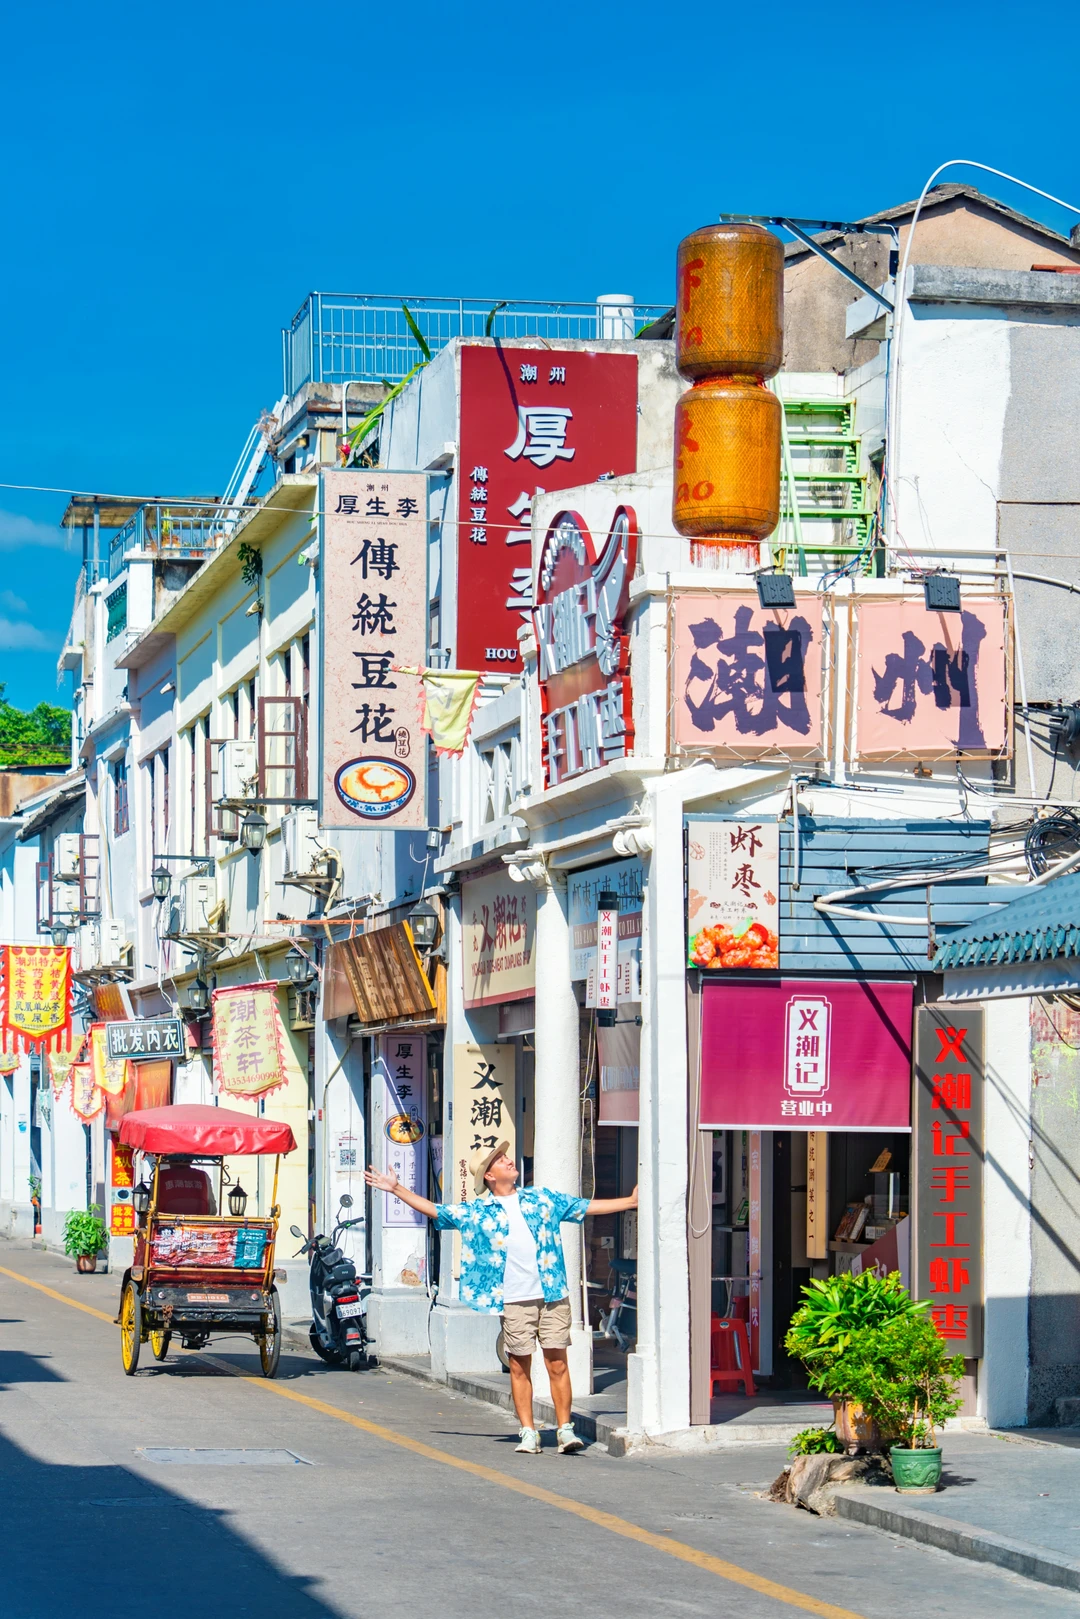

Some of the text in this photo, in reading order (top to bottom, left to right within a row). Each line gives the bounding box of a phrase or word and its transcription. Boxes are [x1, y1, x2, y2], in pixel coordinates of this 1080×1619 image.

[520, 363, 567, 382] 潮州
[366, 484, 389, 492] 潮州
[334, 494, 419, 518] 厚生李
[469, 466, 488, 543] 傳統豆花
[350, 537, 401, 744] 傳統豆花
[533, 576, 598, 682] 义潮记
[485, 647, 518, 661] HOU
[685, 604, 813, 736] 潮
[870, 609, 988, 751] 州
[729, 825, 763, 898] 虾枣
[15, 957, 60, 967] 潮州特产
[15, 968, 61, 978] 老药桔
[15, 980, 60, 990] 老香黄
[15, 1002, 60, 1012] 凤凰单丛茶
[15, 1013, 60, 1023] 鸭屎香
[111, 1024, 179, 1053] 批发内衣
[229, 999, 264, 1074] 潮茶轩
[795, 1008, 820, 1084] 义潮记
[395, 1043, 413, 1099] 厚生李
[780, 1100, 832, 1117] 营业中
